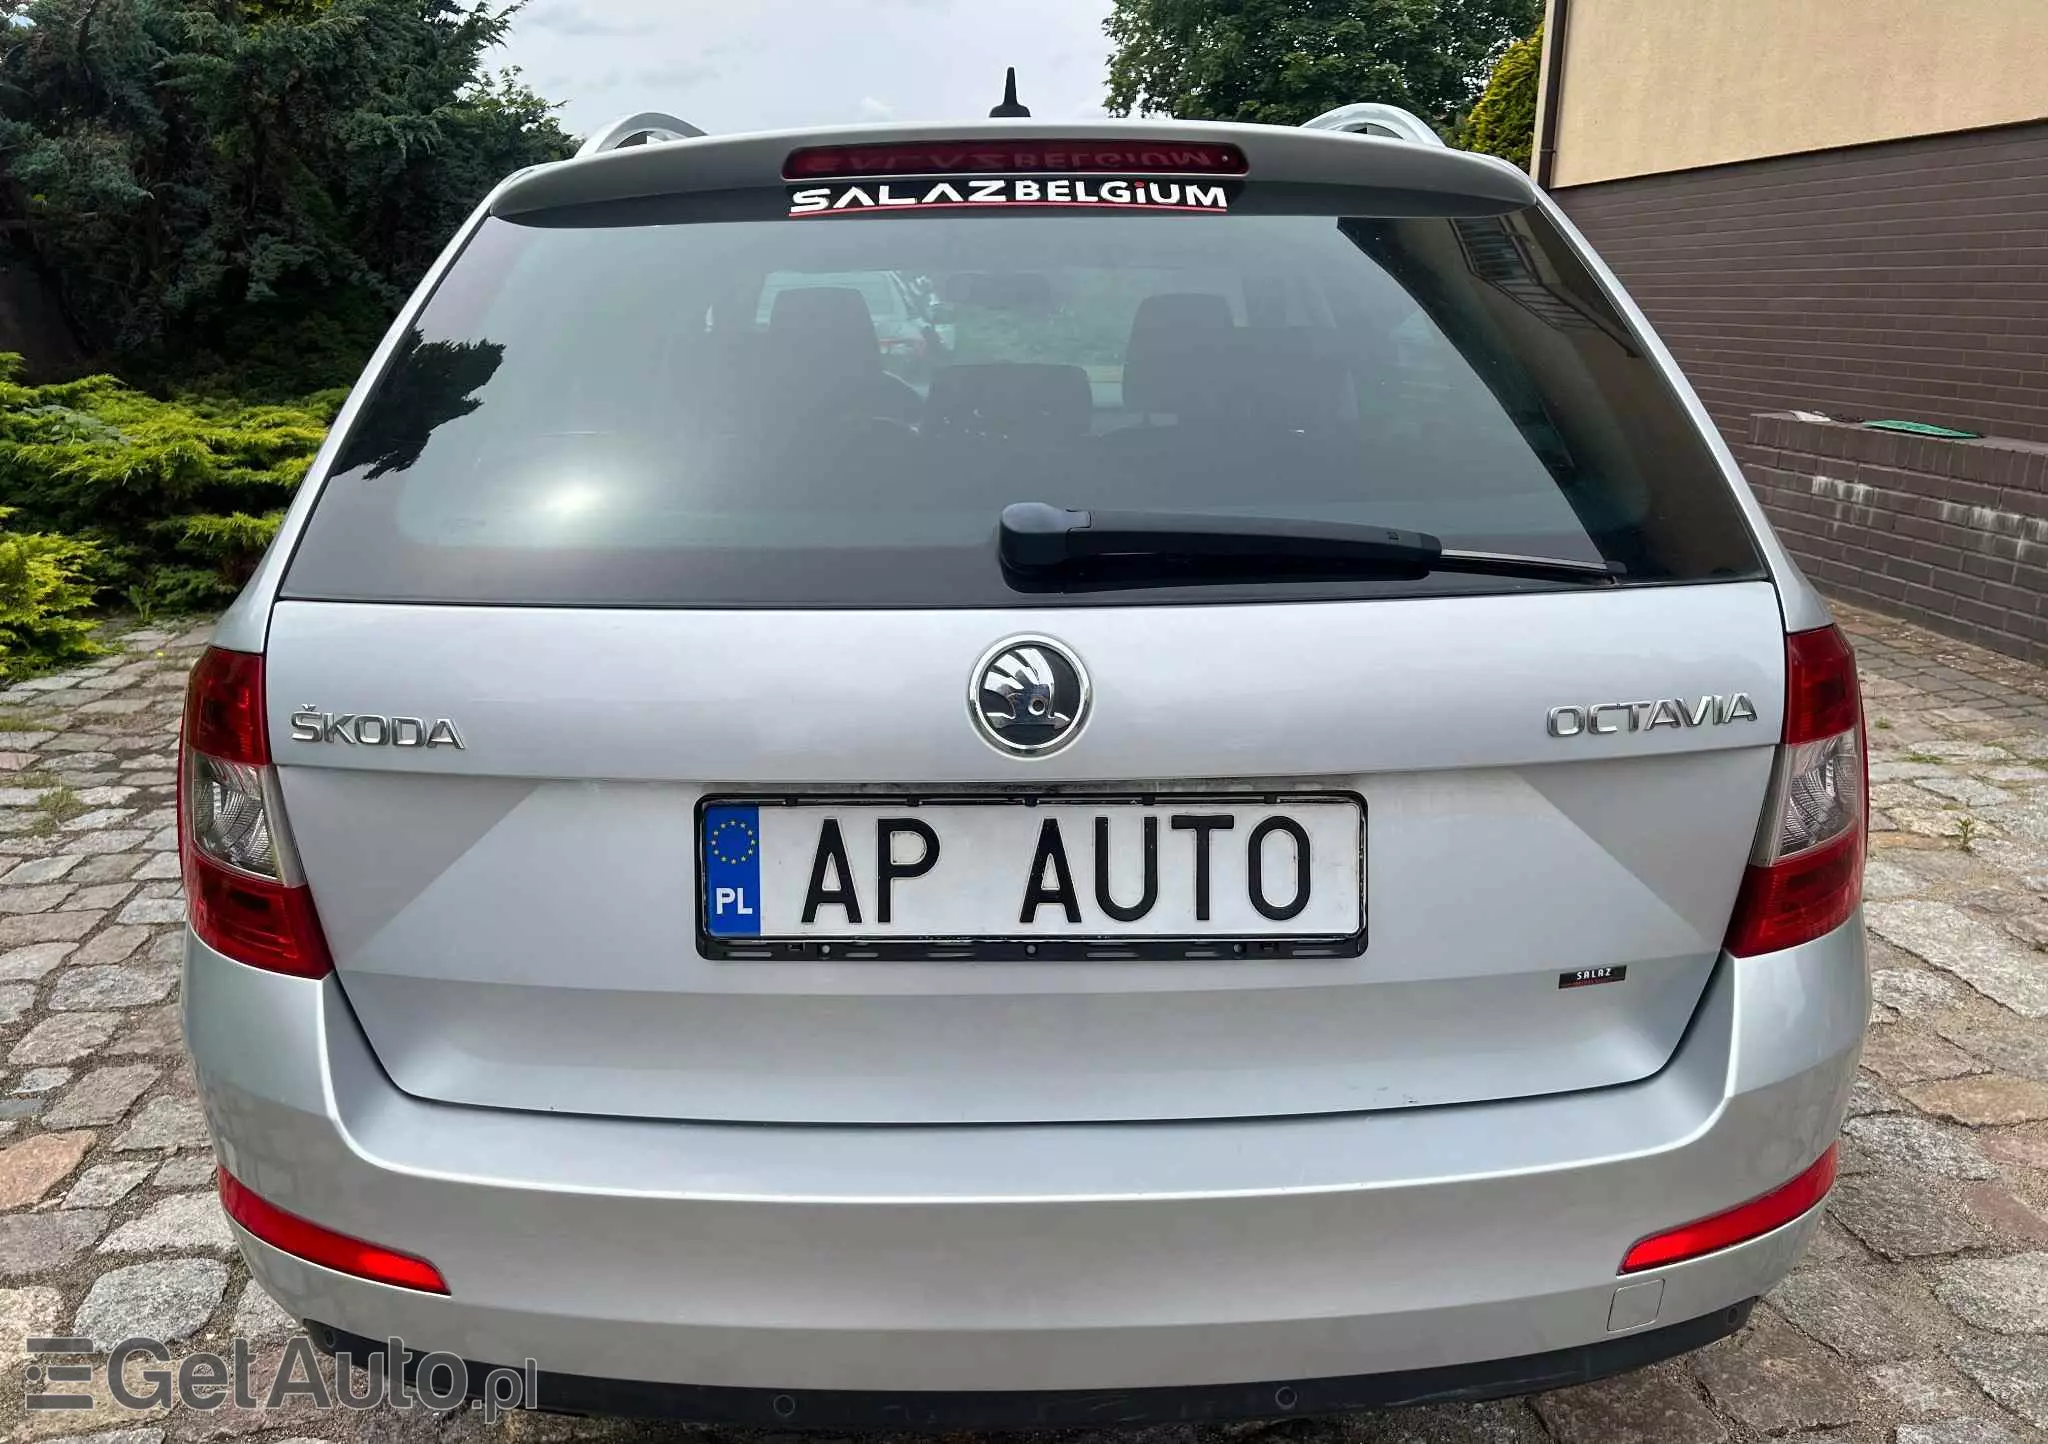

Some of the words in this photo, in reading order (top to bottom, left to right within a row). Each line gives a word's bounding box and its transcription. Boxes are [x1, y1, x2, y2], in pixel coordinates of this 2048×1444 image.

[291, 703, 466, 749] ŠKODA
[1547, 692, 1758, 737] OCTAVIA
[801, 817, 940, 923] AP
[1020, 815, 1311, 923] AUTO
[716, 887, 753, 915] PL
[1576, 967, 1613, 980] SALAZ
